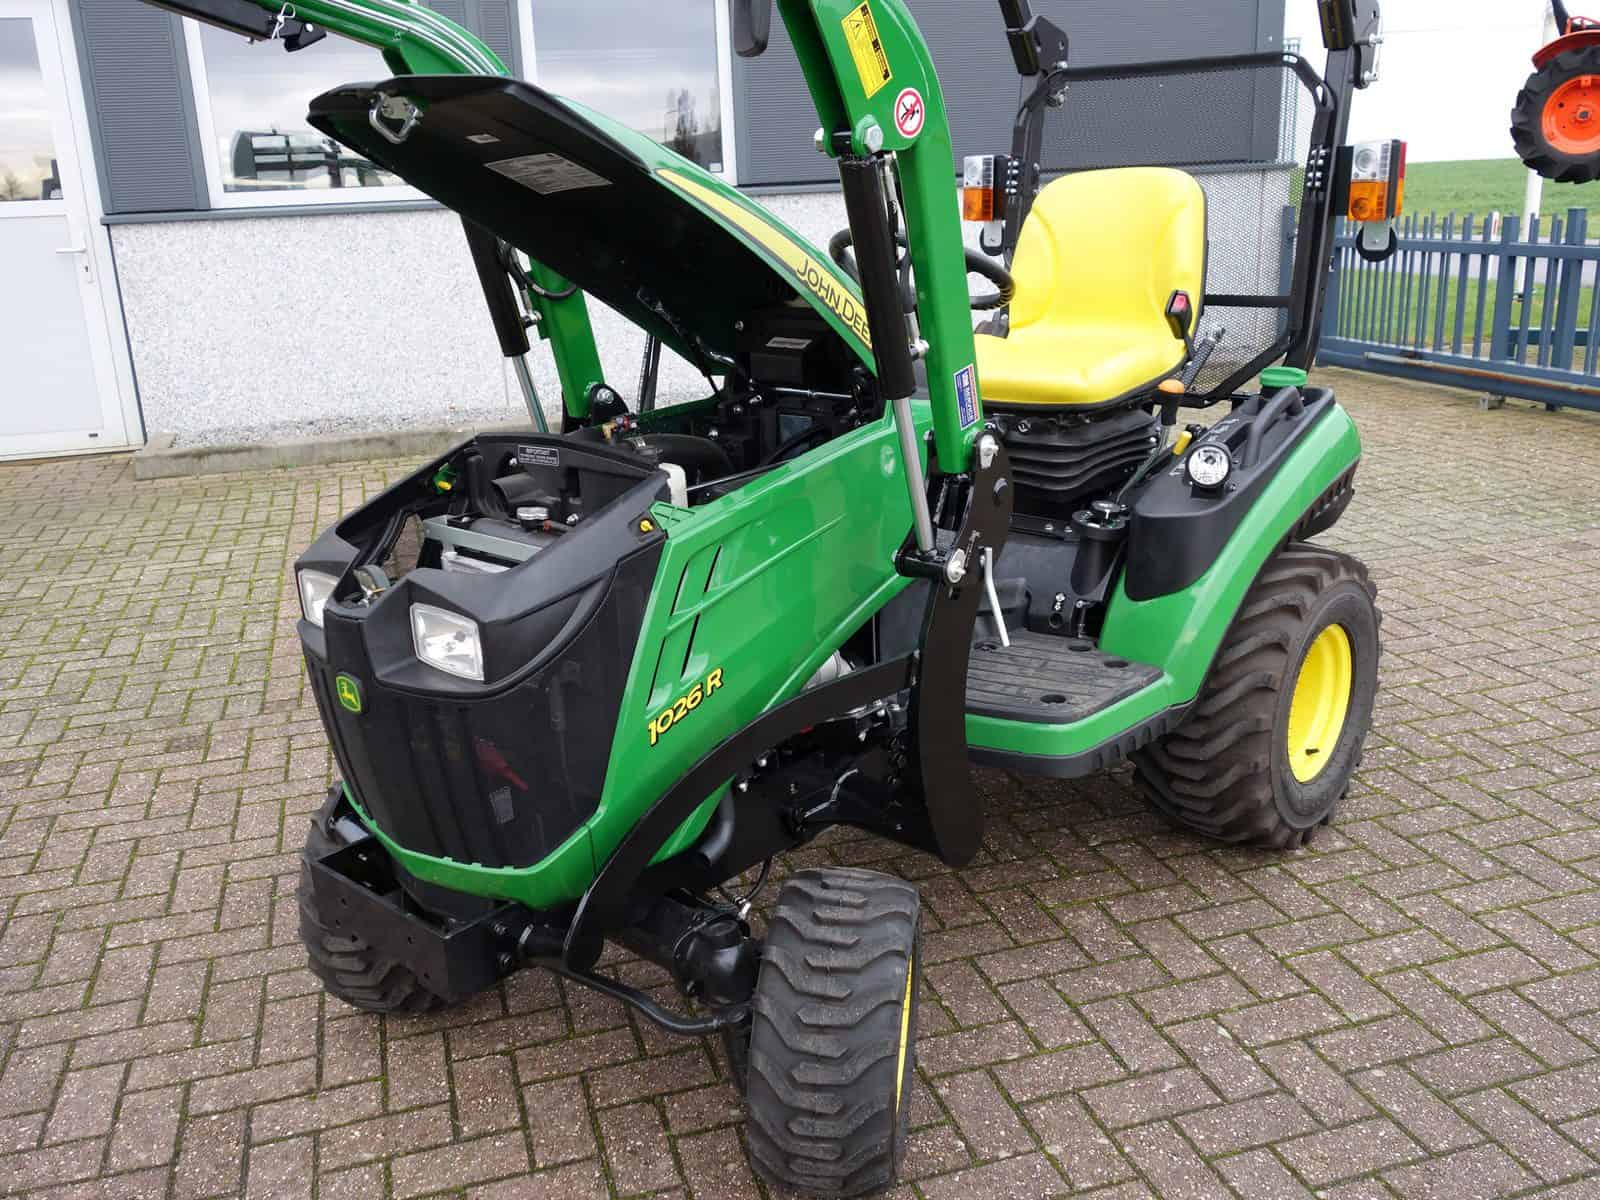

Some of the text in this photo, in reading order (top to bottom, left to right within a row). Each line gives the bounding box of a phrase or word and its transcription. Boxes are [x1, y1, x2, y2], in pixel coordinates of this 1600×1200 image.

[797, 259, 872, 344] JOHN DEE
[648, 667, 723, 746] 1026 R
